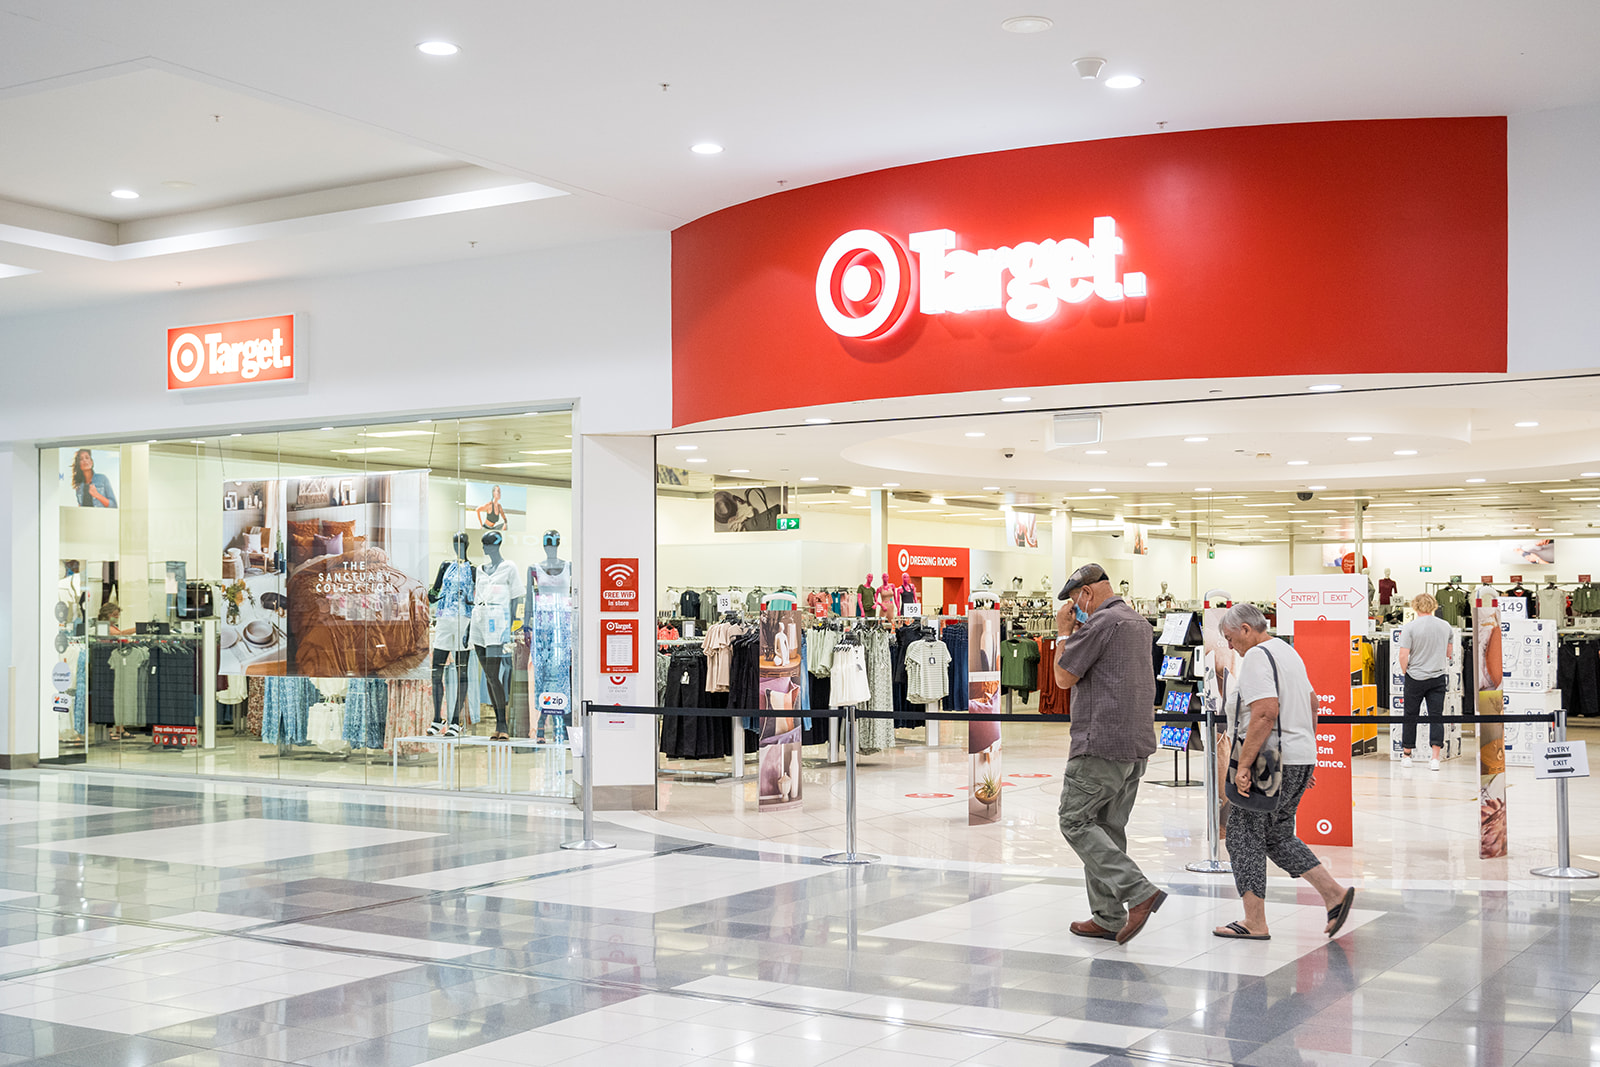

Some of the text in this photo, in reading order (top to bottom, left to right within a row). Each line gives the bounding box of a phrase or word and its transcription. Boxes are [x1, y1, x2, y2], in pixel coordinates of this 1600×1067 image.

[909, 216, 1147, 323] Target.
[205, 328, 291, 379] Target.
[343, 561, 366, 570] THE
[910, 556, 957, 566] DRESSING ROOMS
[318, 572, 391, 582] SANCTUARY
[316, 584, 393, 593] COLLECTION
[552, 696, 563, 705] zip
[1316, 694, 1336, 703] eep
[1317, 706, 1335, 715] afe.
[1316, 734, 1336, 743] eep
[1316, 759, 1346, 768] tance.
